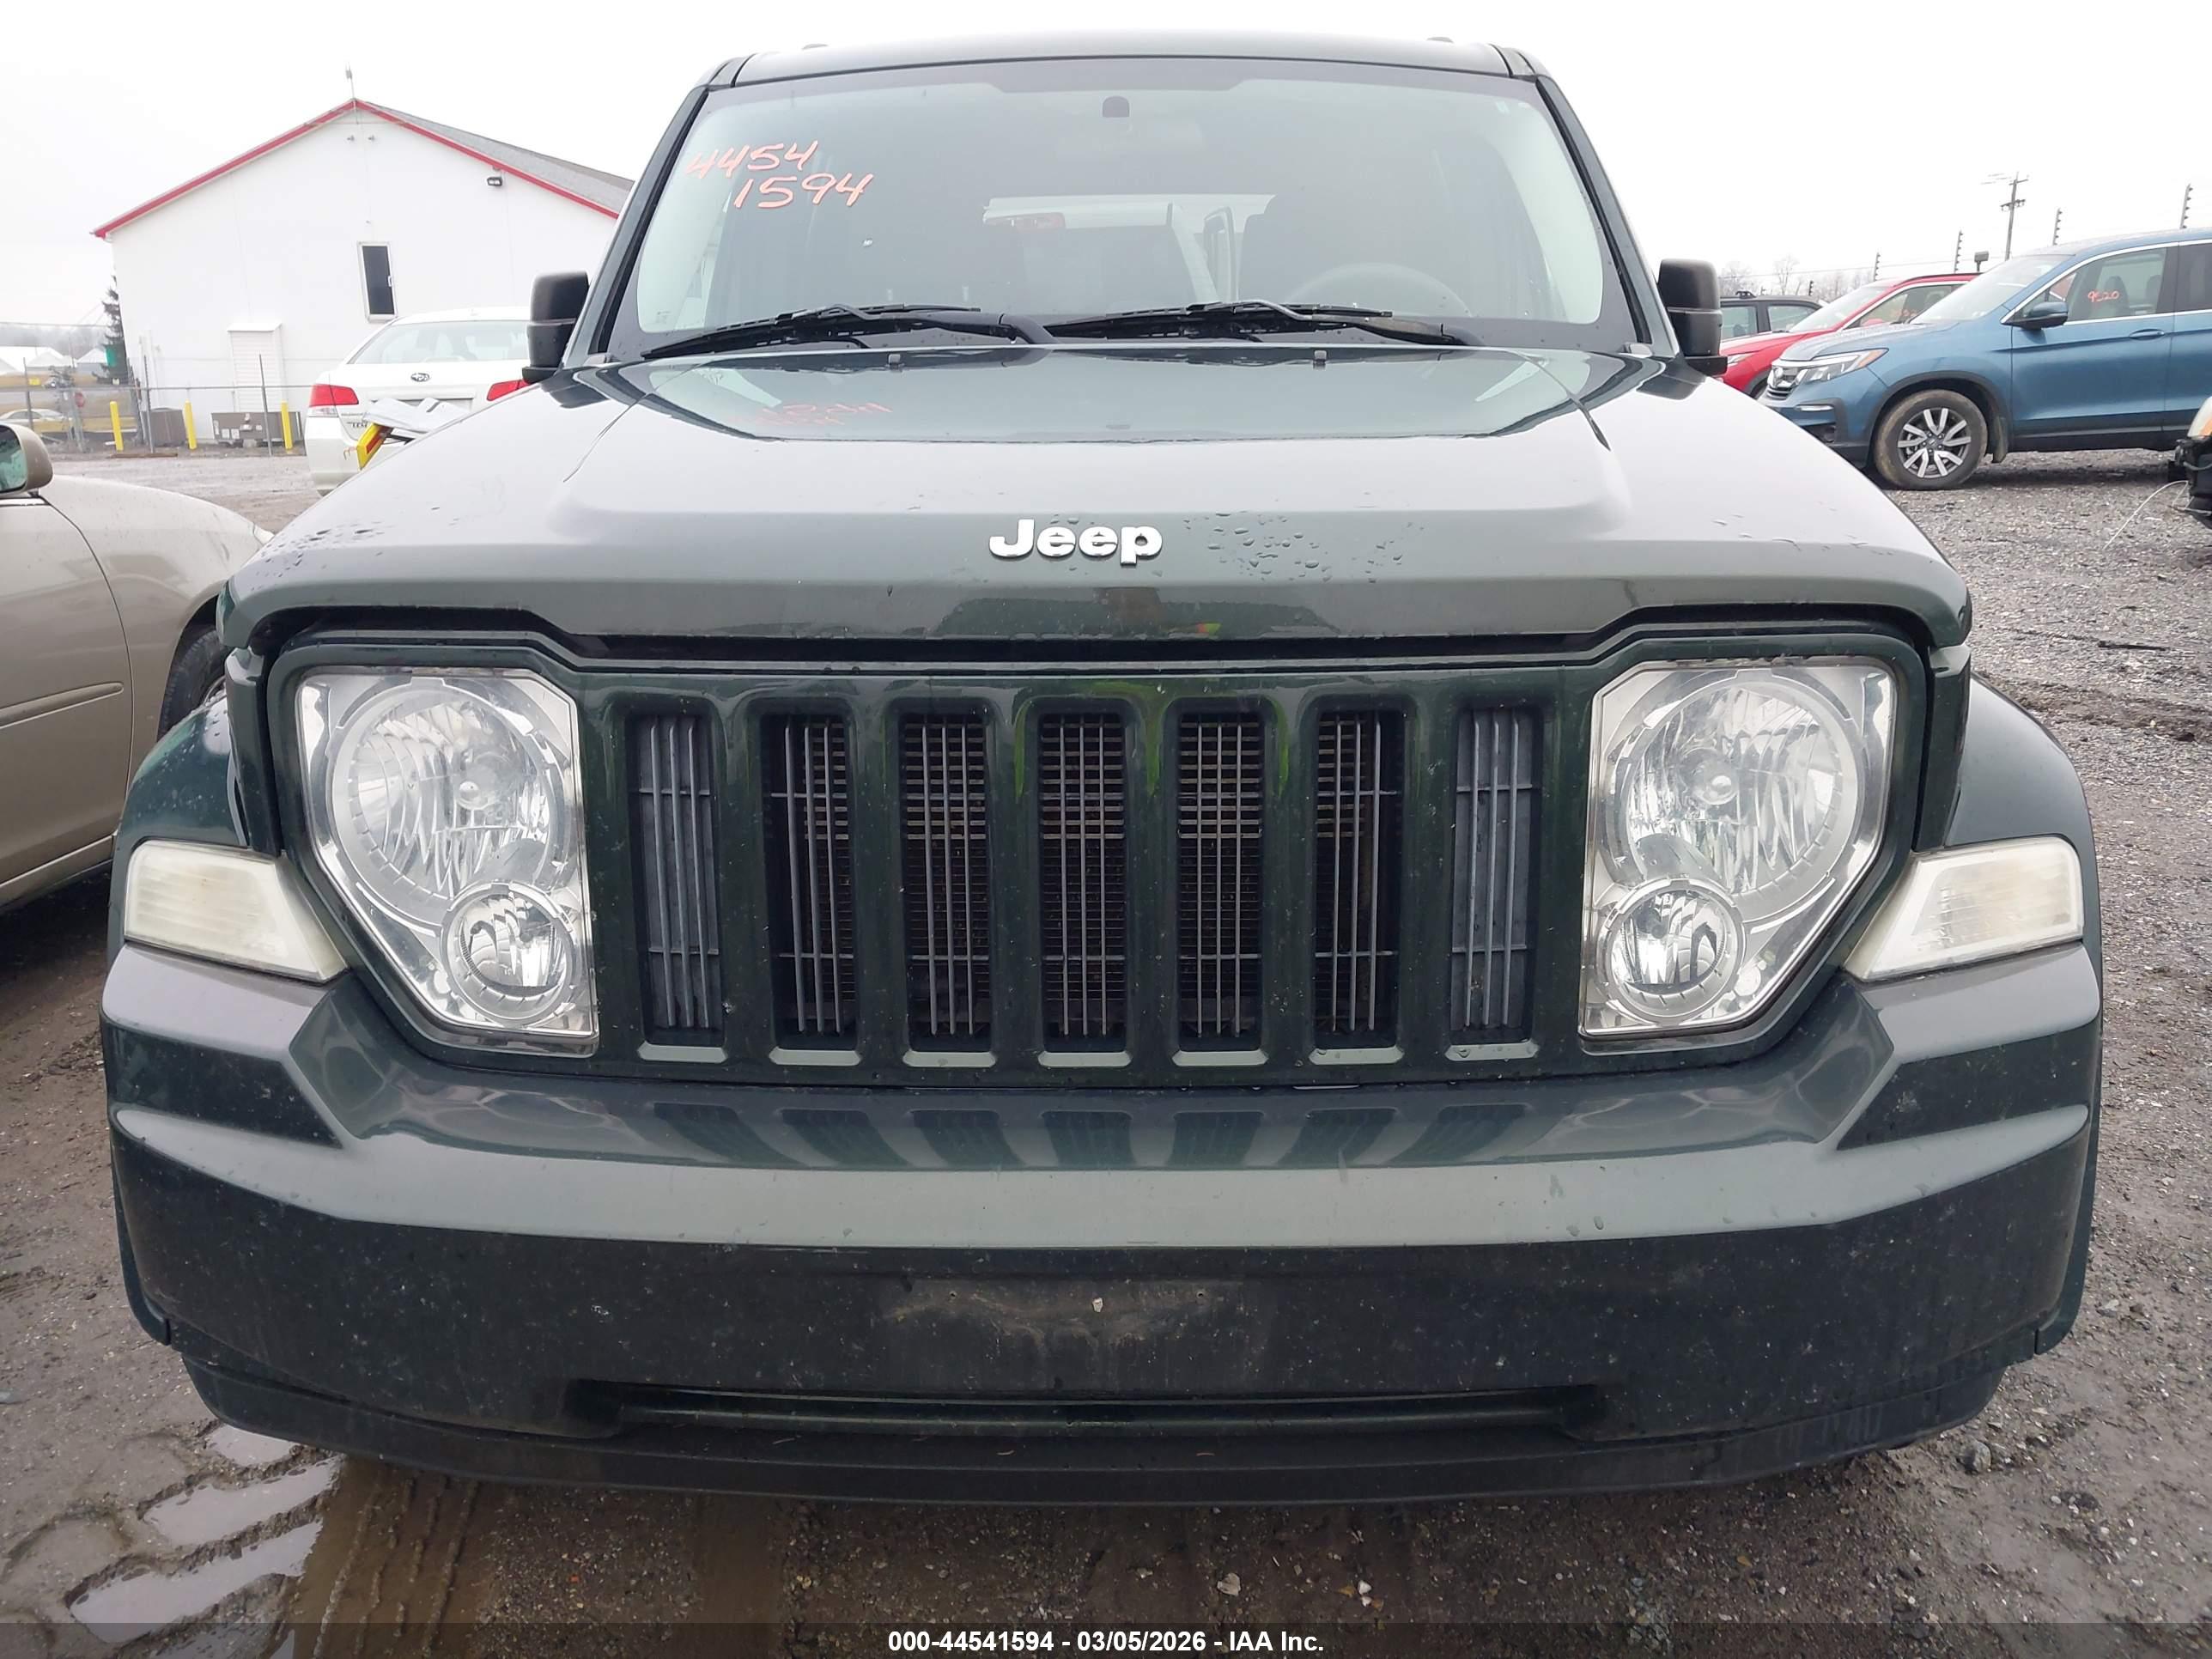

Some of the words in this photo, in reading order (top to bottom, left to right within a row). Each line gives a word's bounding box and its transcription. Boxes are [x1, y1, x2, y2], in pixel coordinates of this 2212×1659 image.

[685, 140, 818, 179] 4454
[733, 172, 874, 209] 1594
[988, 519, 1163, 568] Jeep
